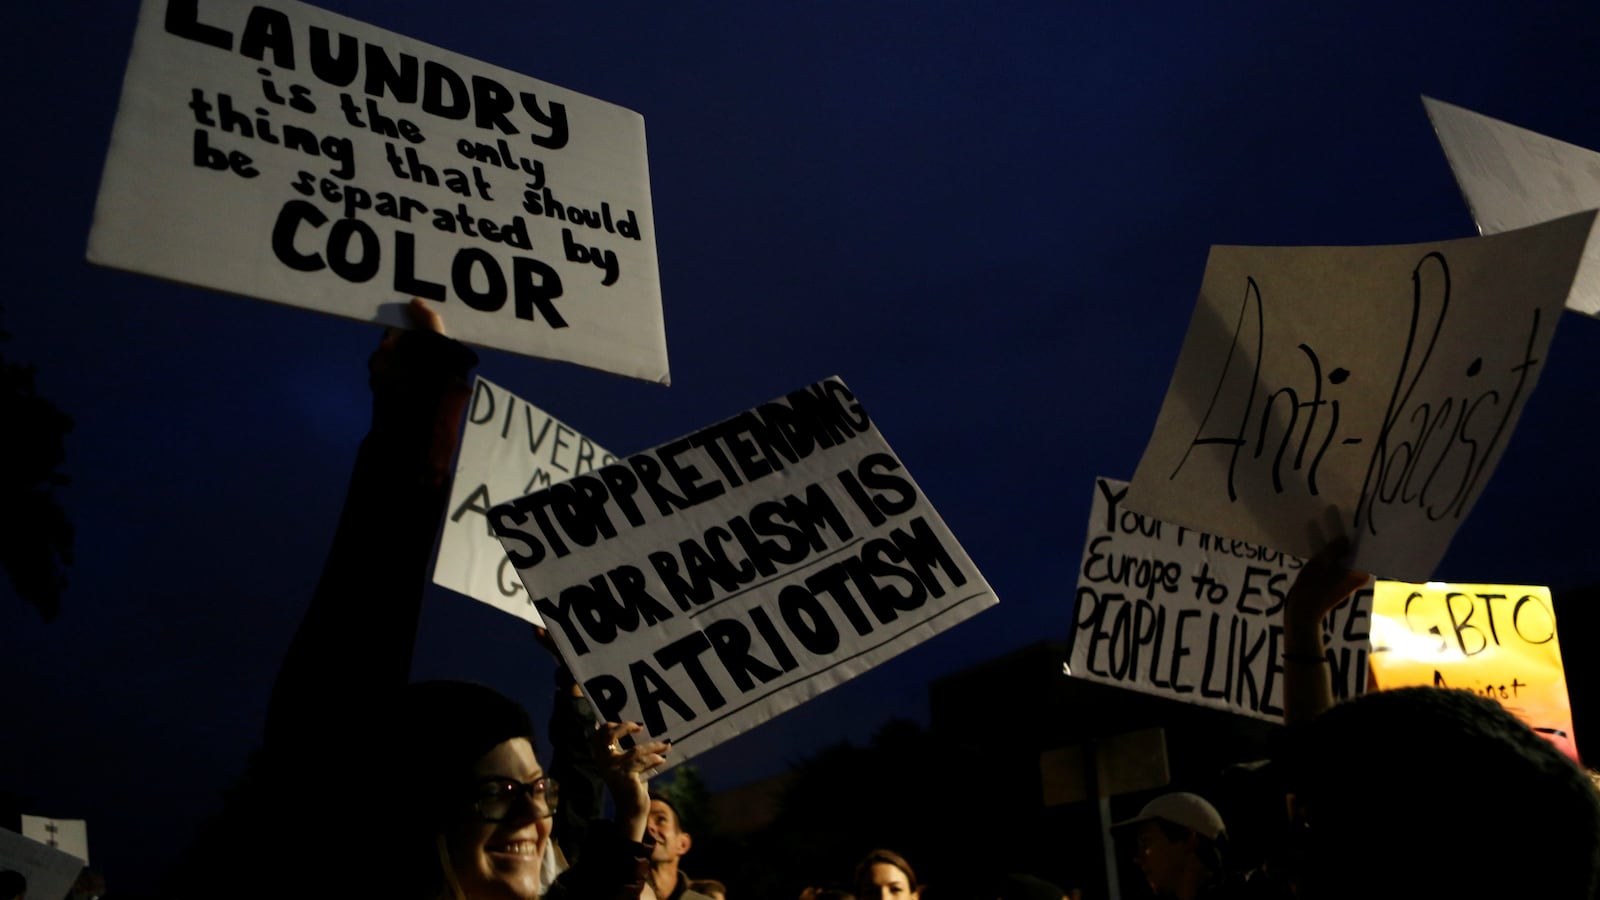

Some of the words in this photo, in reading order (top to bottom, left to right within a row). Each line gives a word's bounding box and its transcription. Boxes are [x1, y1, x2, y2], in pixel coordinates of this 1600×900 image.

[164, 0, 569, 150] LAUNDRY
[256, 68, 317, 114] is
[340, 93, 426, 144] the
[457, 137, 546, 189] only
[188, 88, 355, 180] thing
[385, 142, 493, 201] that
[522, 187, 642, 241] should
[193, 128, 260, 179] be
[291, 170, 533, 250] separated
[562, 228, 620, 286] by
[271, 199, 569, 329] COLOR
[487, 475, 618, 570] STOP
[594, 378, 871, 530] PRETENDING
[537, 564, 675, 657] YOUR
[648, 483, 855, 608] RACISM
[842, 452, 919, 528] IS
[1084, 536, 1182, 600] Europe
[1191, 563, 1229, 604] to
[583, 516, 968, 747] PATRIOTISM
[1067, 587, 1202, 693] PEOPLE
[1200, 612, 1285, 716] LIKE
